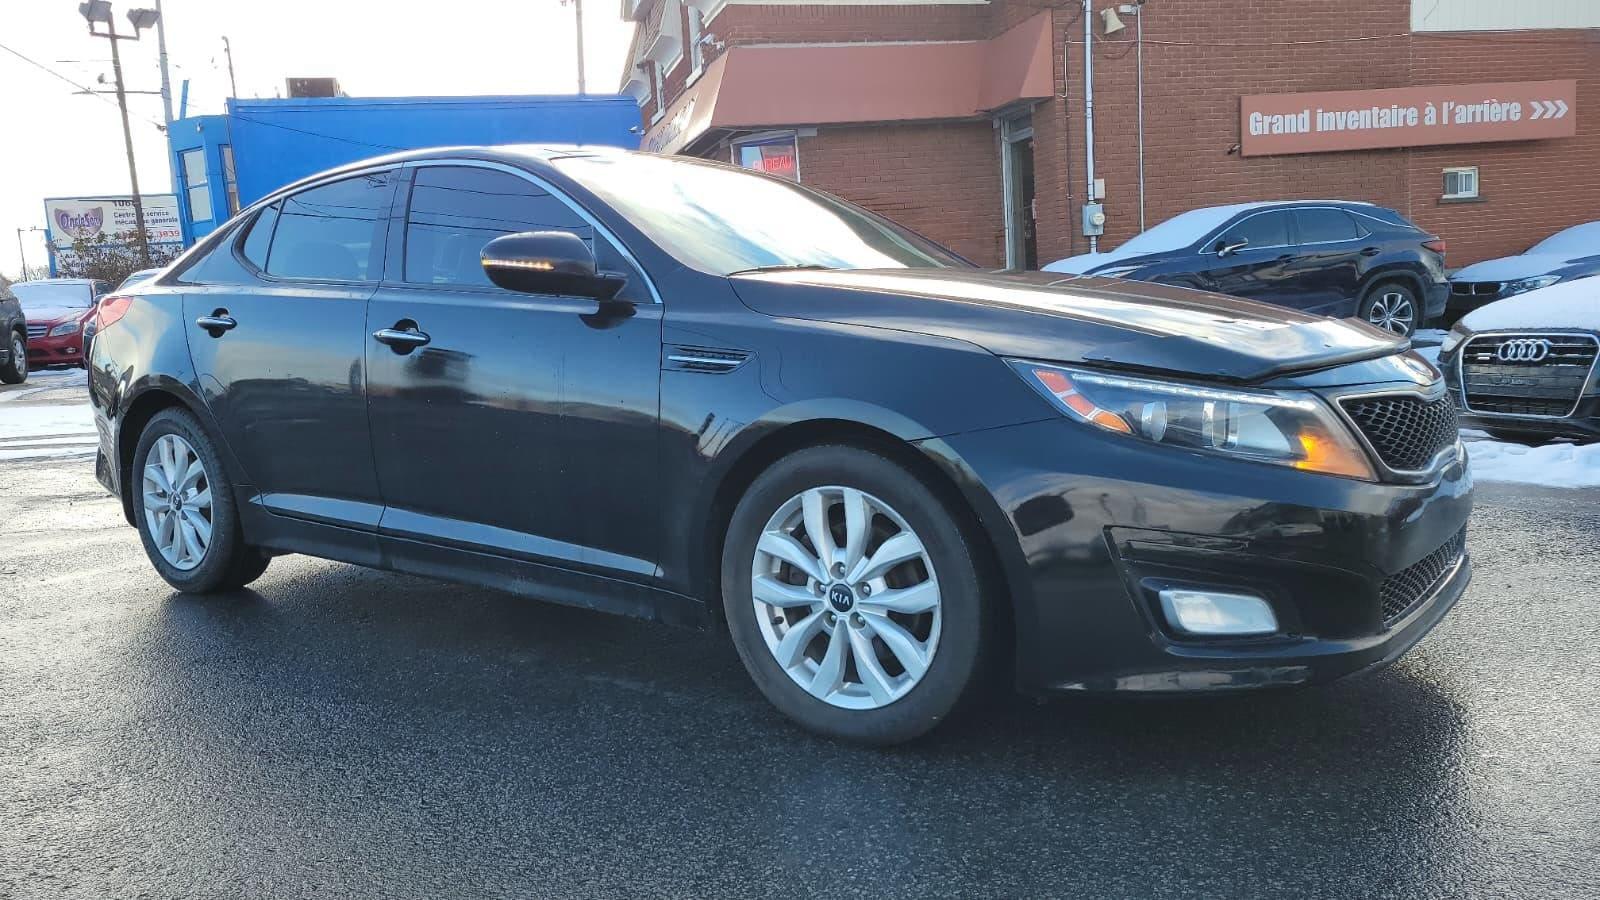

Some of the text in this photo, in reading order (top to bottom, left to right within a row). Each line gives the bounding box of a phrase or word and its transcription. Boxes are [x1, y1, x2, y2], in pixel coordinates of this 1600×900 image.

[1249, 109, 1310, 135] Grand
[1316, 104, 1418, 132] inventaire
[1424, 101, 1437, 126] à
[831, 591, 850, 606] KIA
